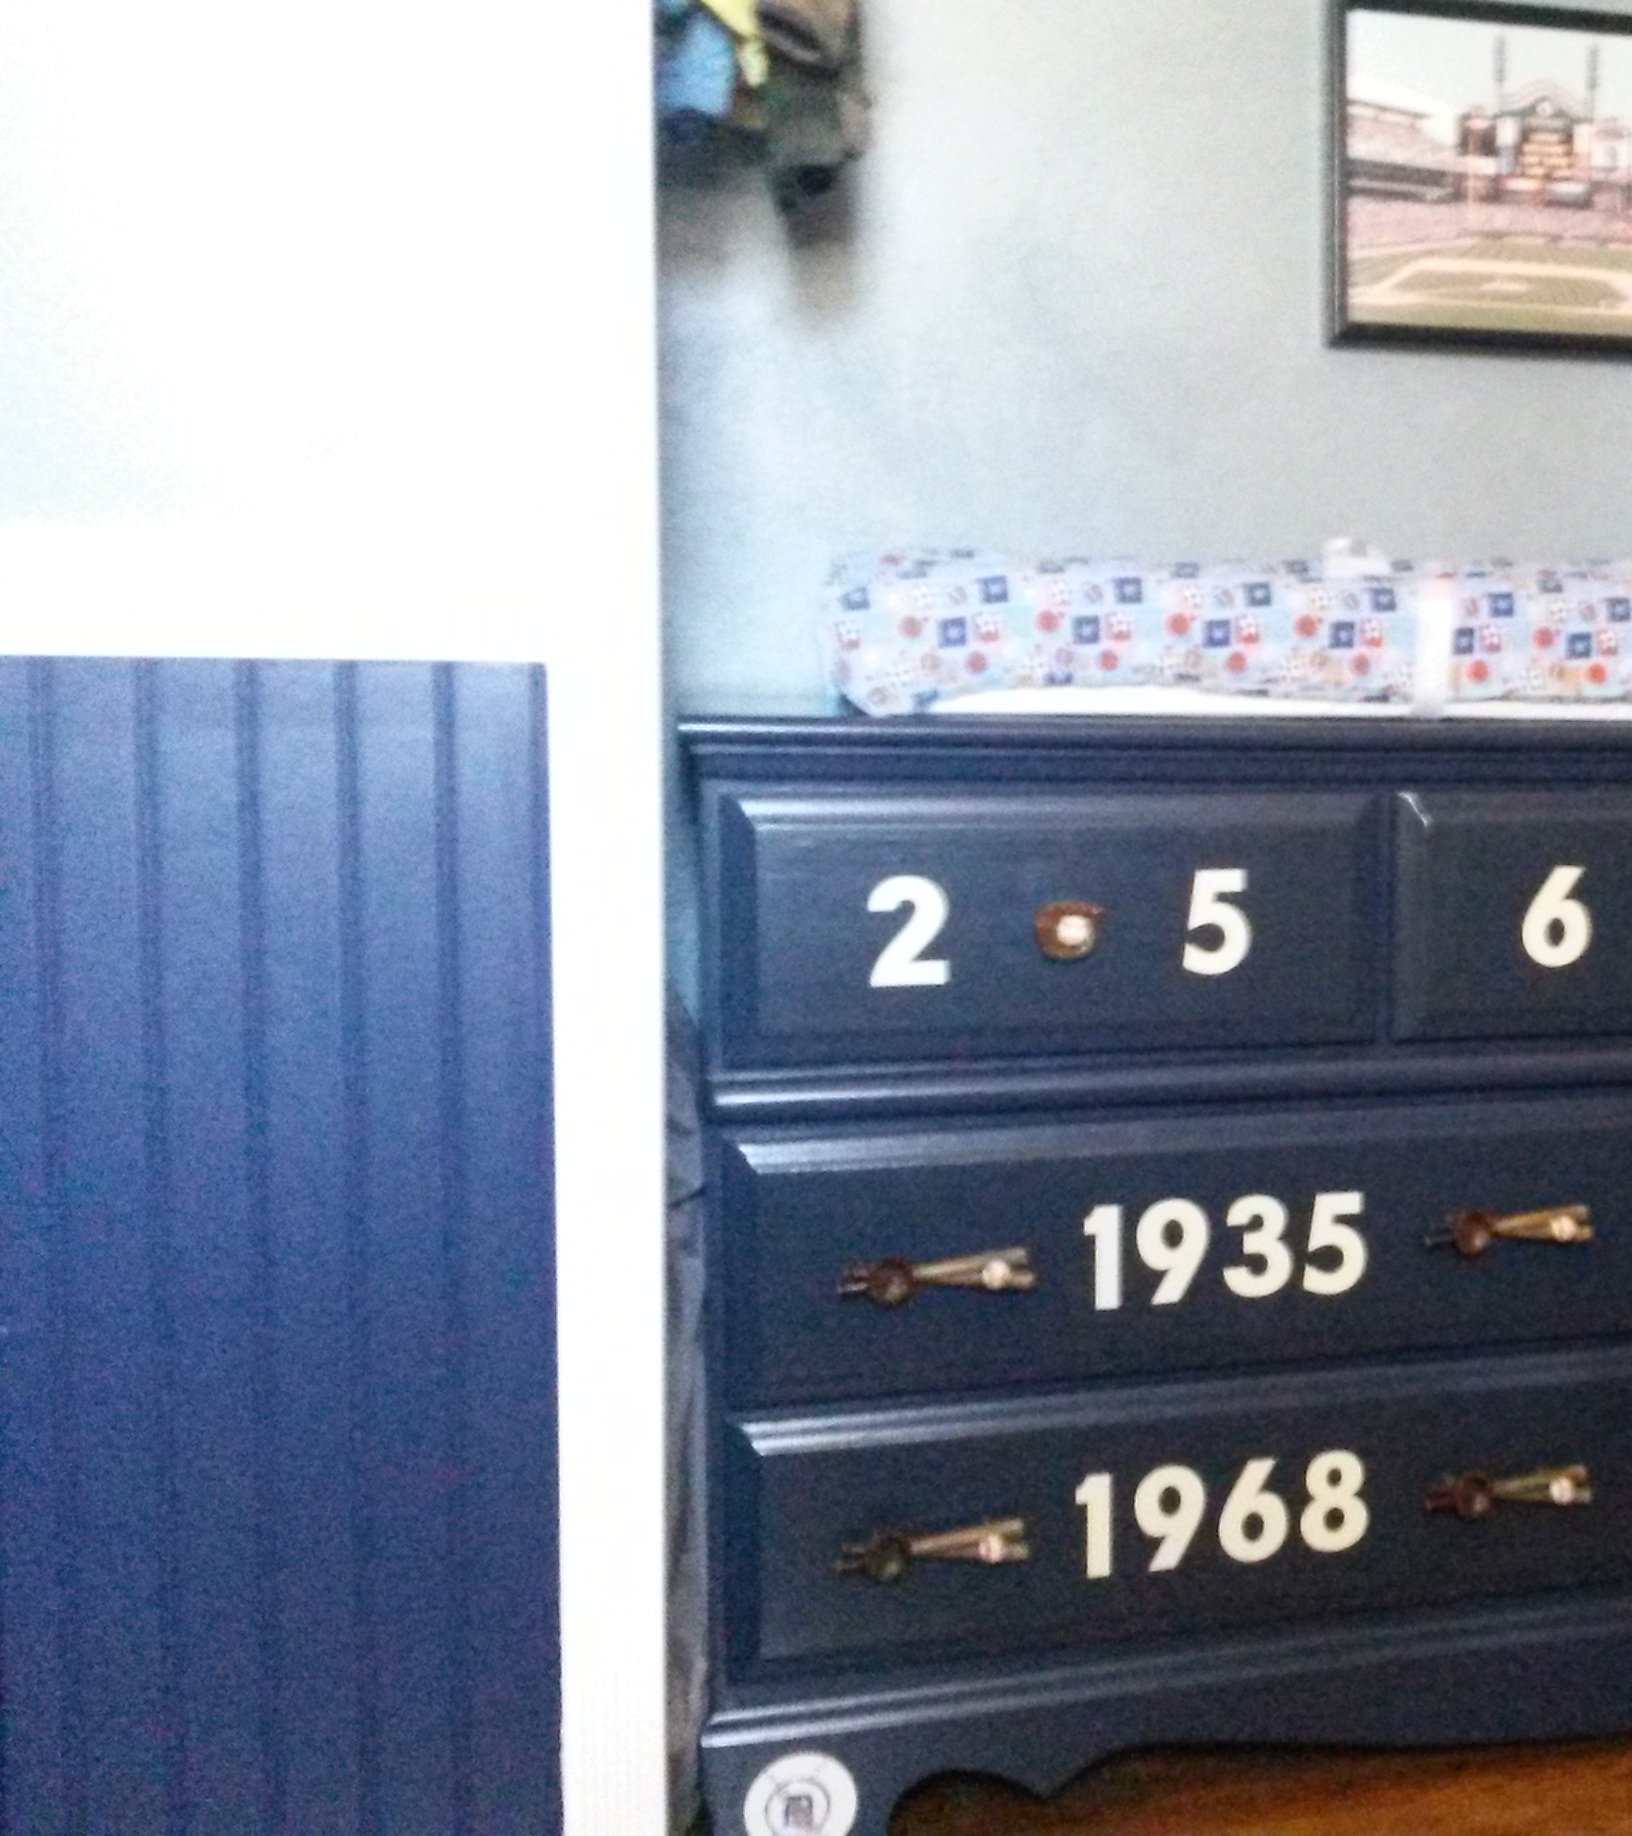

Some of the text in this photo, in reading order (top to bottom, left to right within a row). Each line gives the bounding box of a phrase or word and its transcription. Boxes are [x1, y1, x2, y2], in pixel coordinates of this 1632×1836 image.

[866, 874, 950, 988] 2
[1182, 867, 1252, 976] 5
[1521, 866, 1592, 968] 6
[1083, 1191, 1367, 1311] 1935
[1075, 1451, 1368, 1578] 1968
